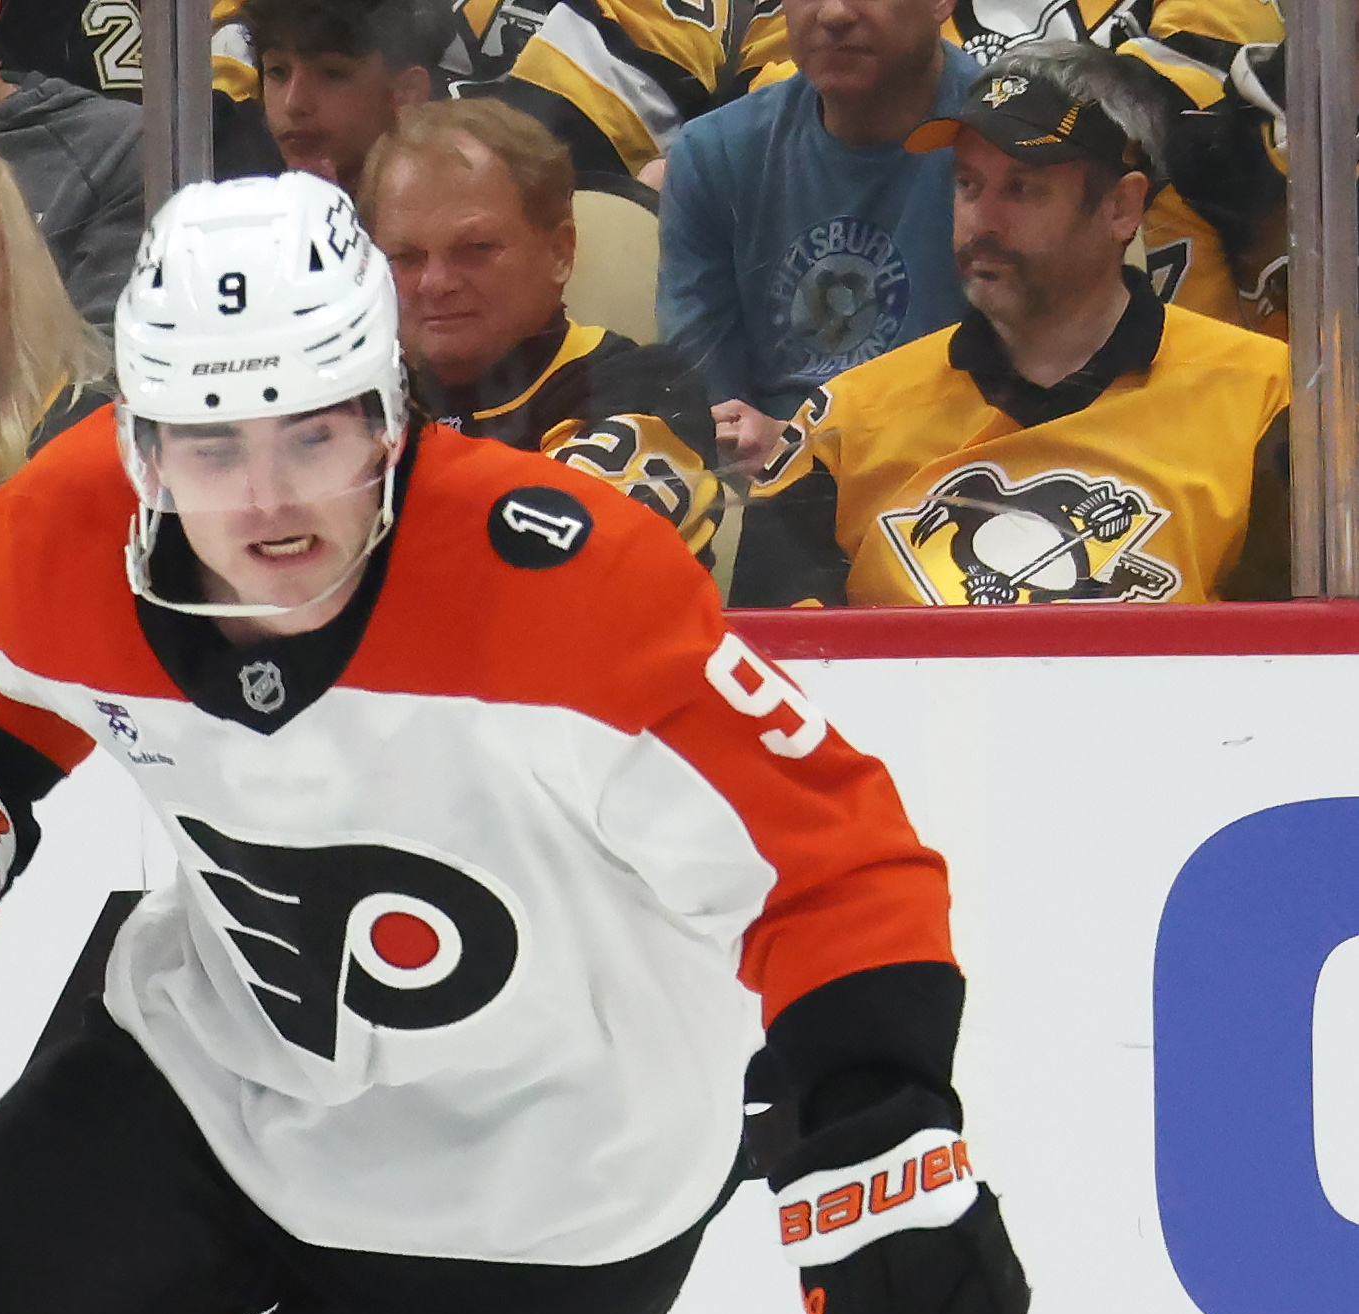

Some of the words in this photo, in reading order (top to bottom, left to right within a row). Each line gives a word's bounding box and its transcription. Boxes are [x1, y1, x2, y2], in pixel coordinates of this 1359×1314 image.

[81, 0, 143, 90] 2
[218, 272, 247, 316] 9
[192, 355, 280, 376] BAUER
[501, 500, 584, 551] 1
[704, 630, 828, 759] 9
[779, 1139, 974, 1245] BAUER
